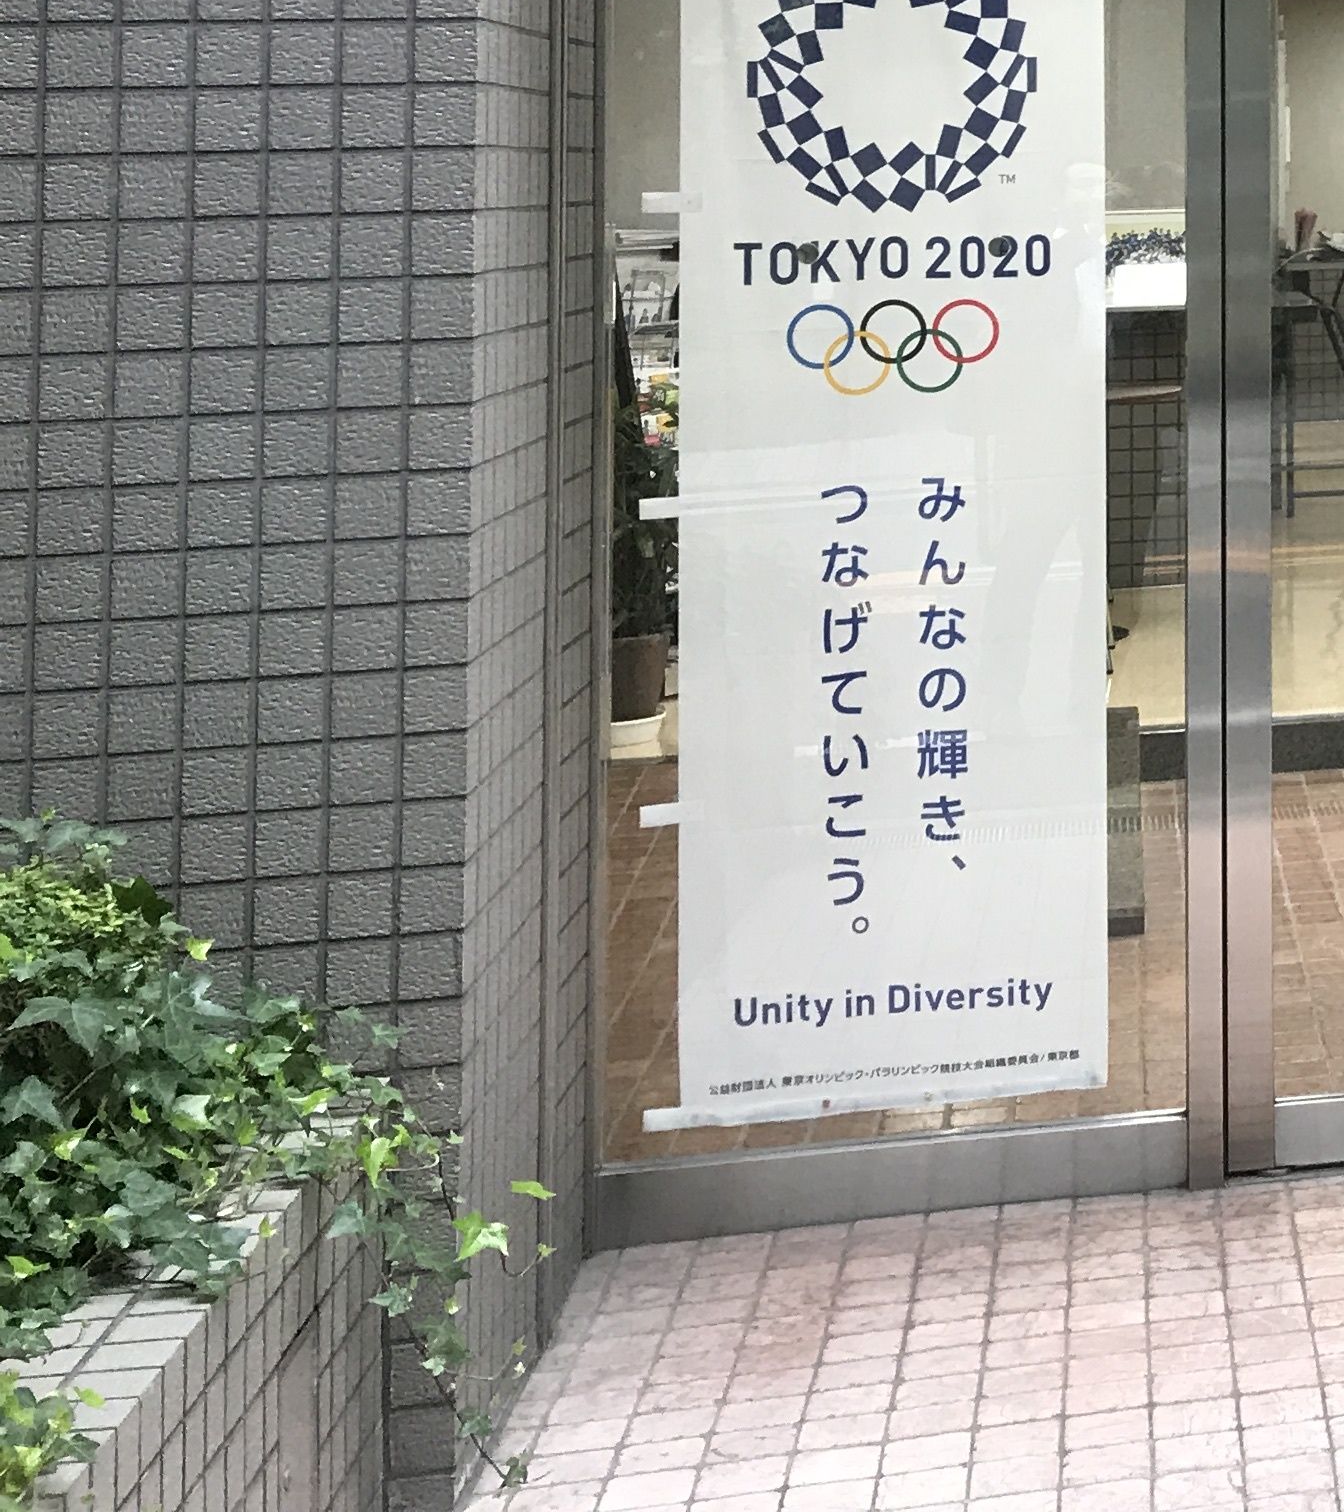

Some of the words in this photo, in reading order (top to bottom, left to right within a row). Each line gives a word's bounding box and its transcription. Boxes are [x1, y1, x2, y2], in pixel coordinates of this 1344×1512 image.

[999, 174, 1016, 184] TM
[733, 237, 909, 286] TOKYO
[925, 234, 1051, 279] 2020
[917, 477, 969, 871] みんなの輝き、
[820, 484, 874, 935] つなげていこう。
[733, 993, 833, 1028] Unity
[845, 989, 875, 1018] in
[888, 977, 1053, 1014] Diversity
